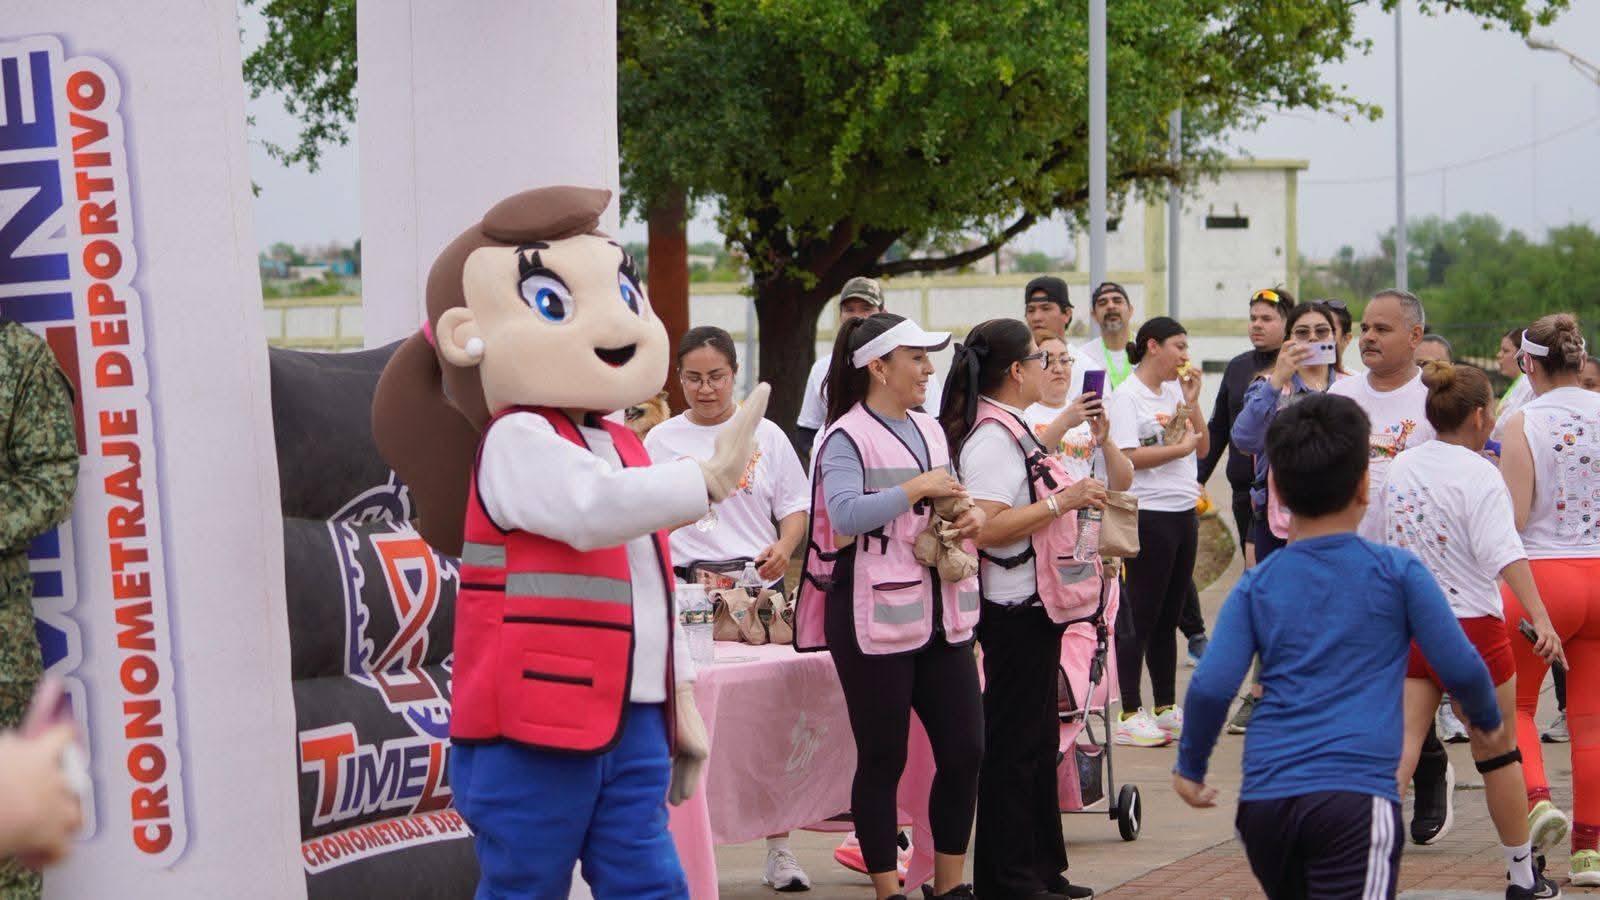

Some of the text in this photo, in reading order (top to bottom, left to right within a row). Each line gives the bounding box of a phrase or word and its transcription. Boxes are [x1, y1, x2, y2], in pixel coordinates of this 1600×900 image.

[66, 70, 173, 855] CRONOMETRAJE DEPORTIVO
[301, 732, 455, 817] TIMEL
[301, 810, 464, 867] CRONOMETRAJE DEP
